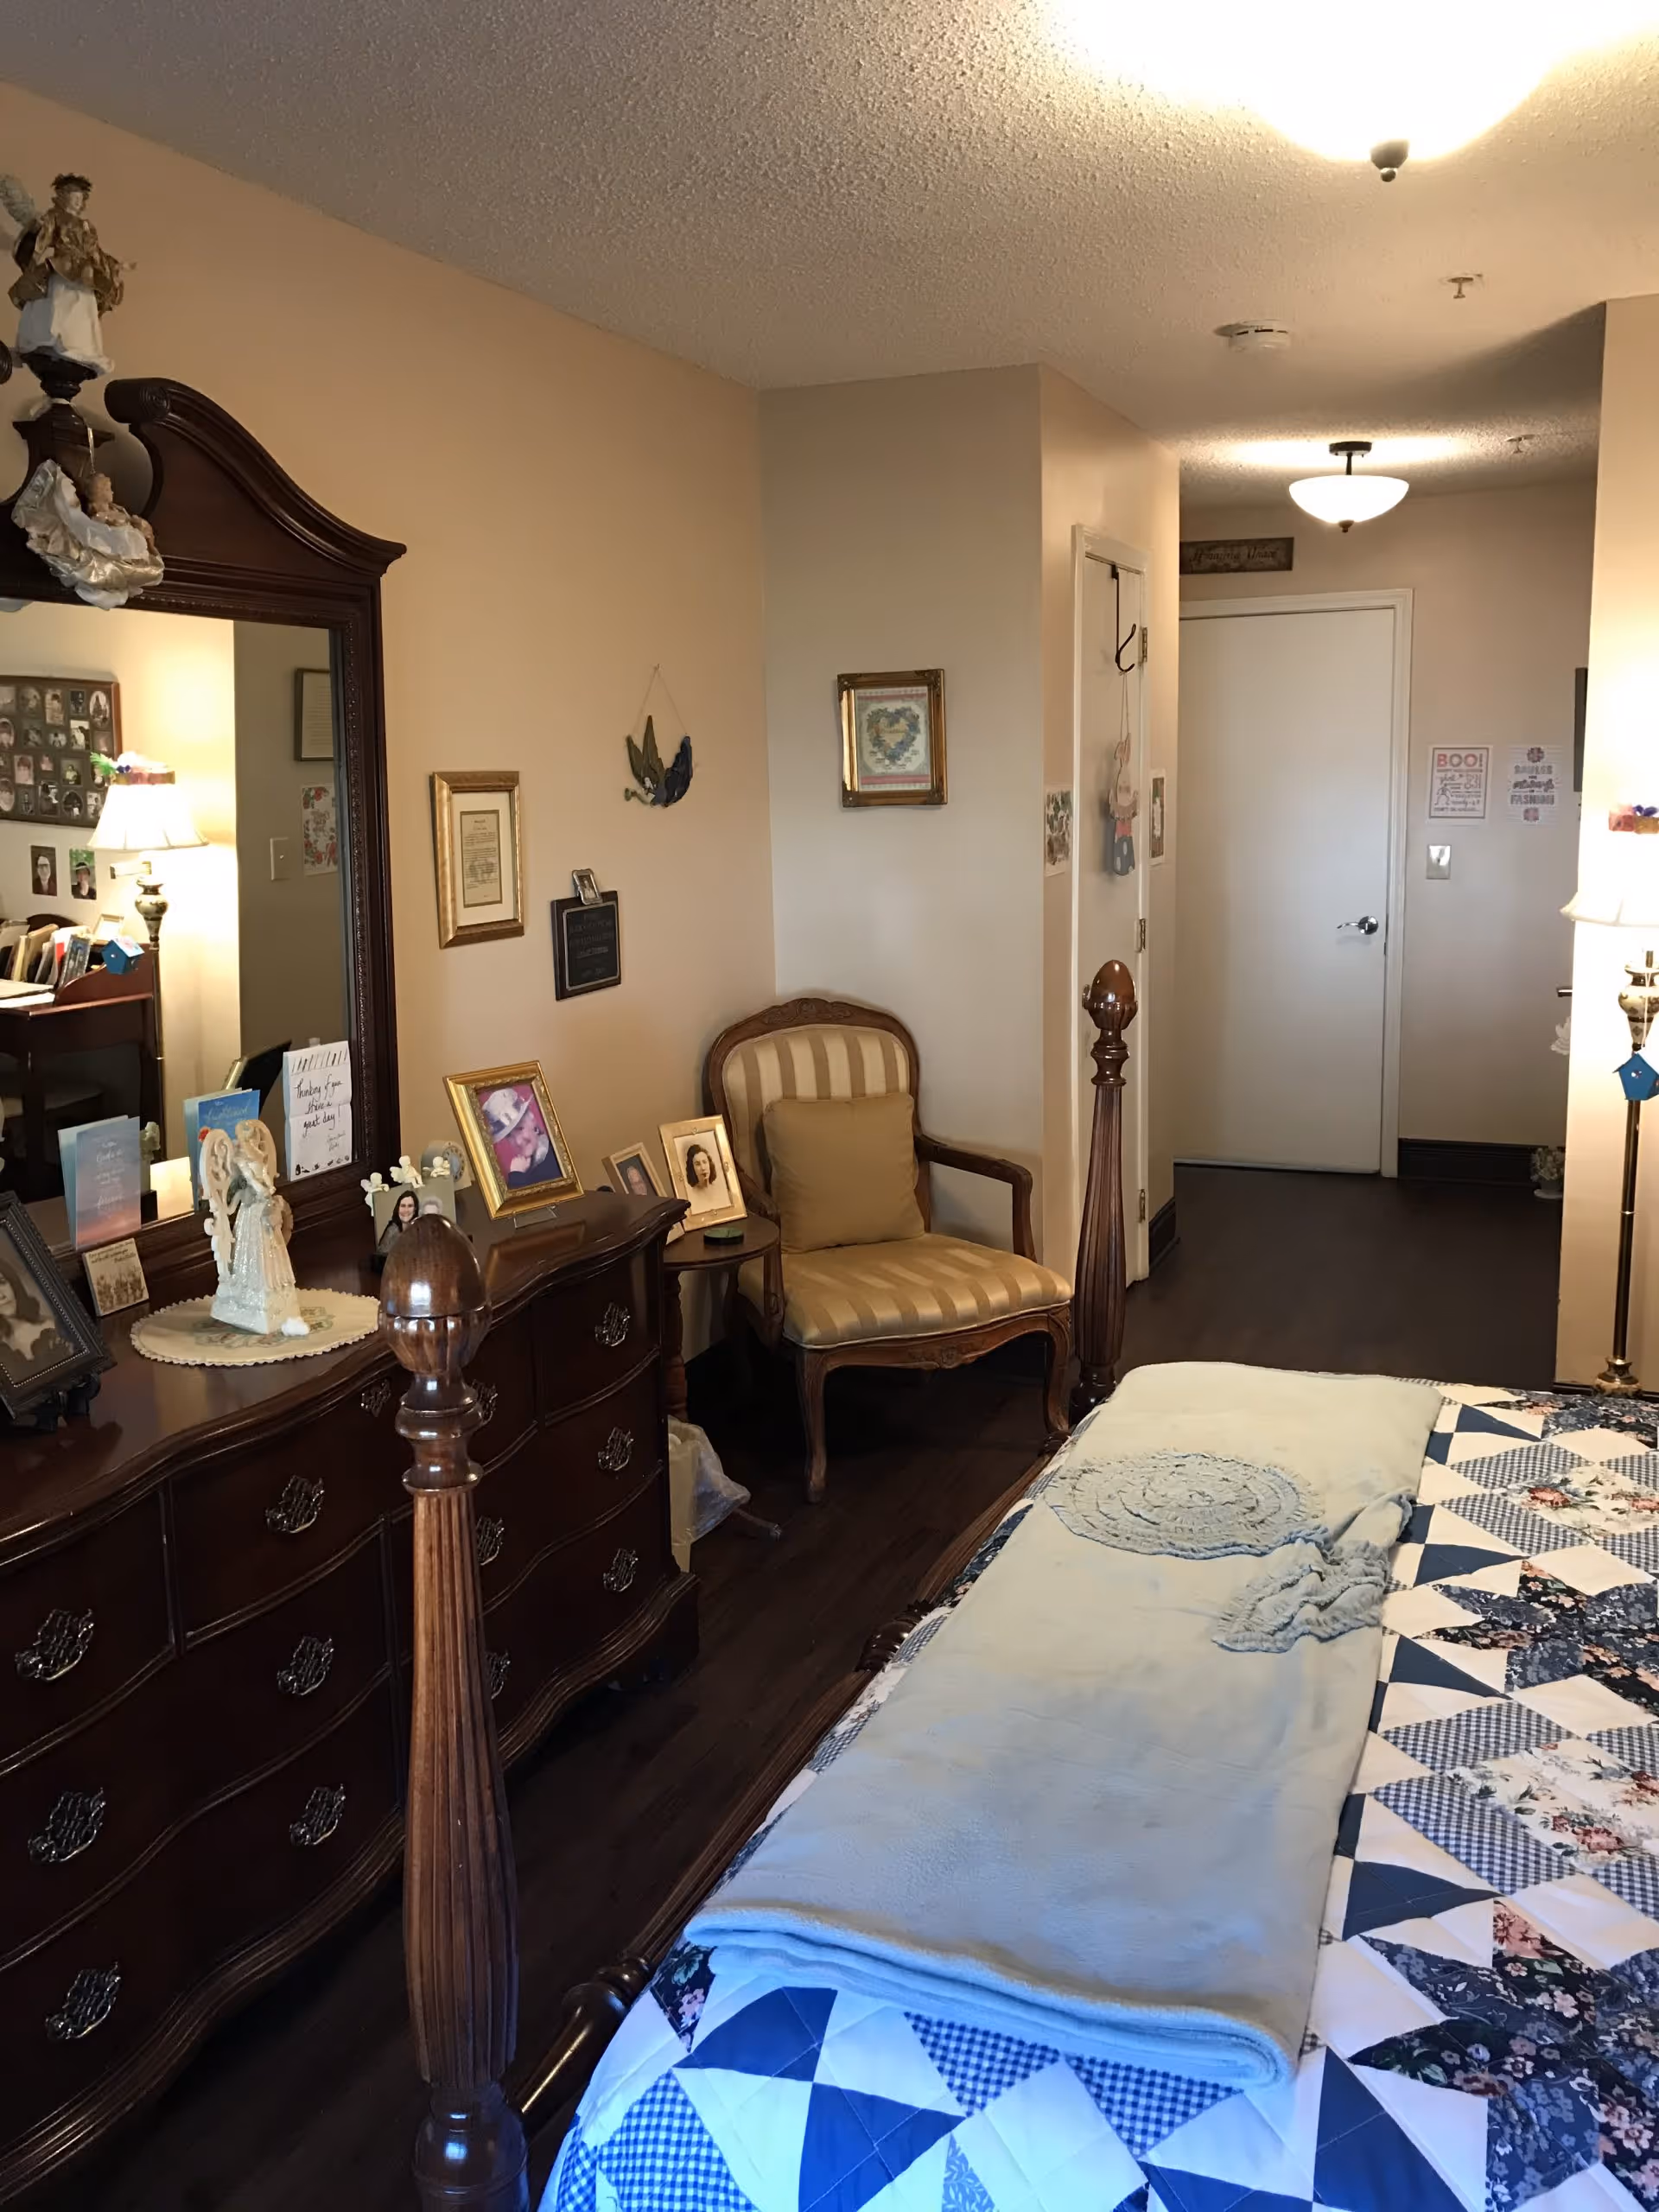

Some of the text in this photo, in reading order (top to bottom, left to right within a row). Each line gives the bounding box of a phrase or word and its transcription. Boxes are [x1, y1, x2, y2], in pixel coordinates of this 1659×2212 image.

[1437, 753, 1483, 767] BOO!
[294, 1077, 321, 1102] Thinking
[325, 1073, 333, 1100] of
[302, 1114, 320, 1138] great
